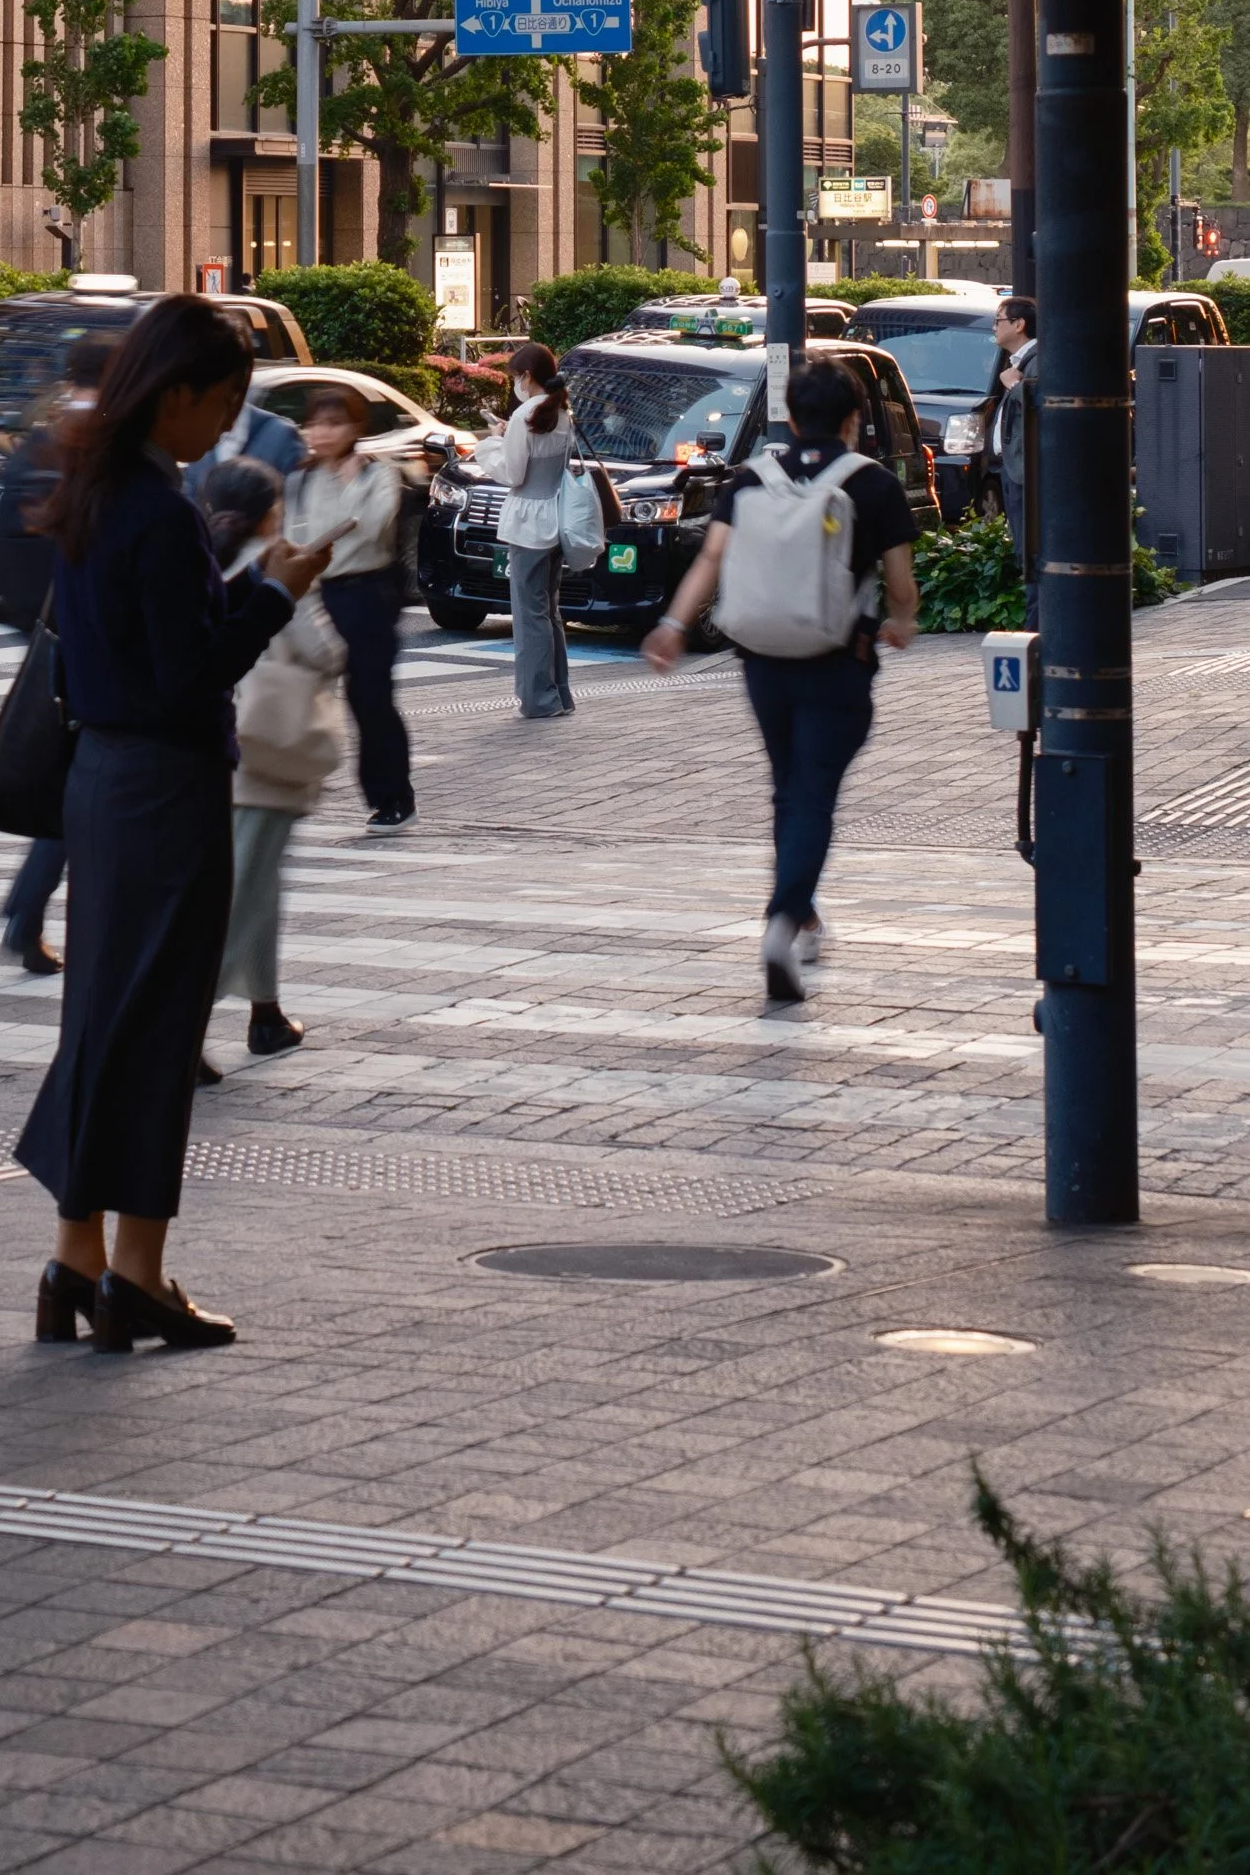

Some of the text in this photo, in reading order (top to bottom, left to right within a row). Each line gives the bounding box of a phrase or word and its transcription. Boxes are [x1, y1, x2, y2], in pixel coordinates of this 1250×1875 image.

[489, 15, 496, 30] 1
[517, 17, 567, 31] 日比谷通り
[590, 13, 597, 27] 1
[872, 63, 901, 74] 8-20
